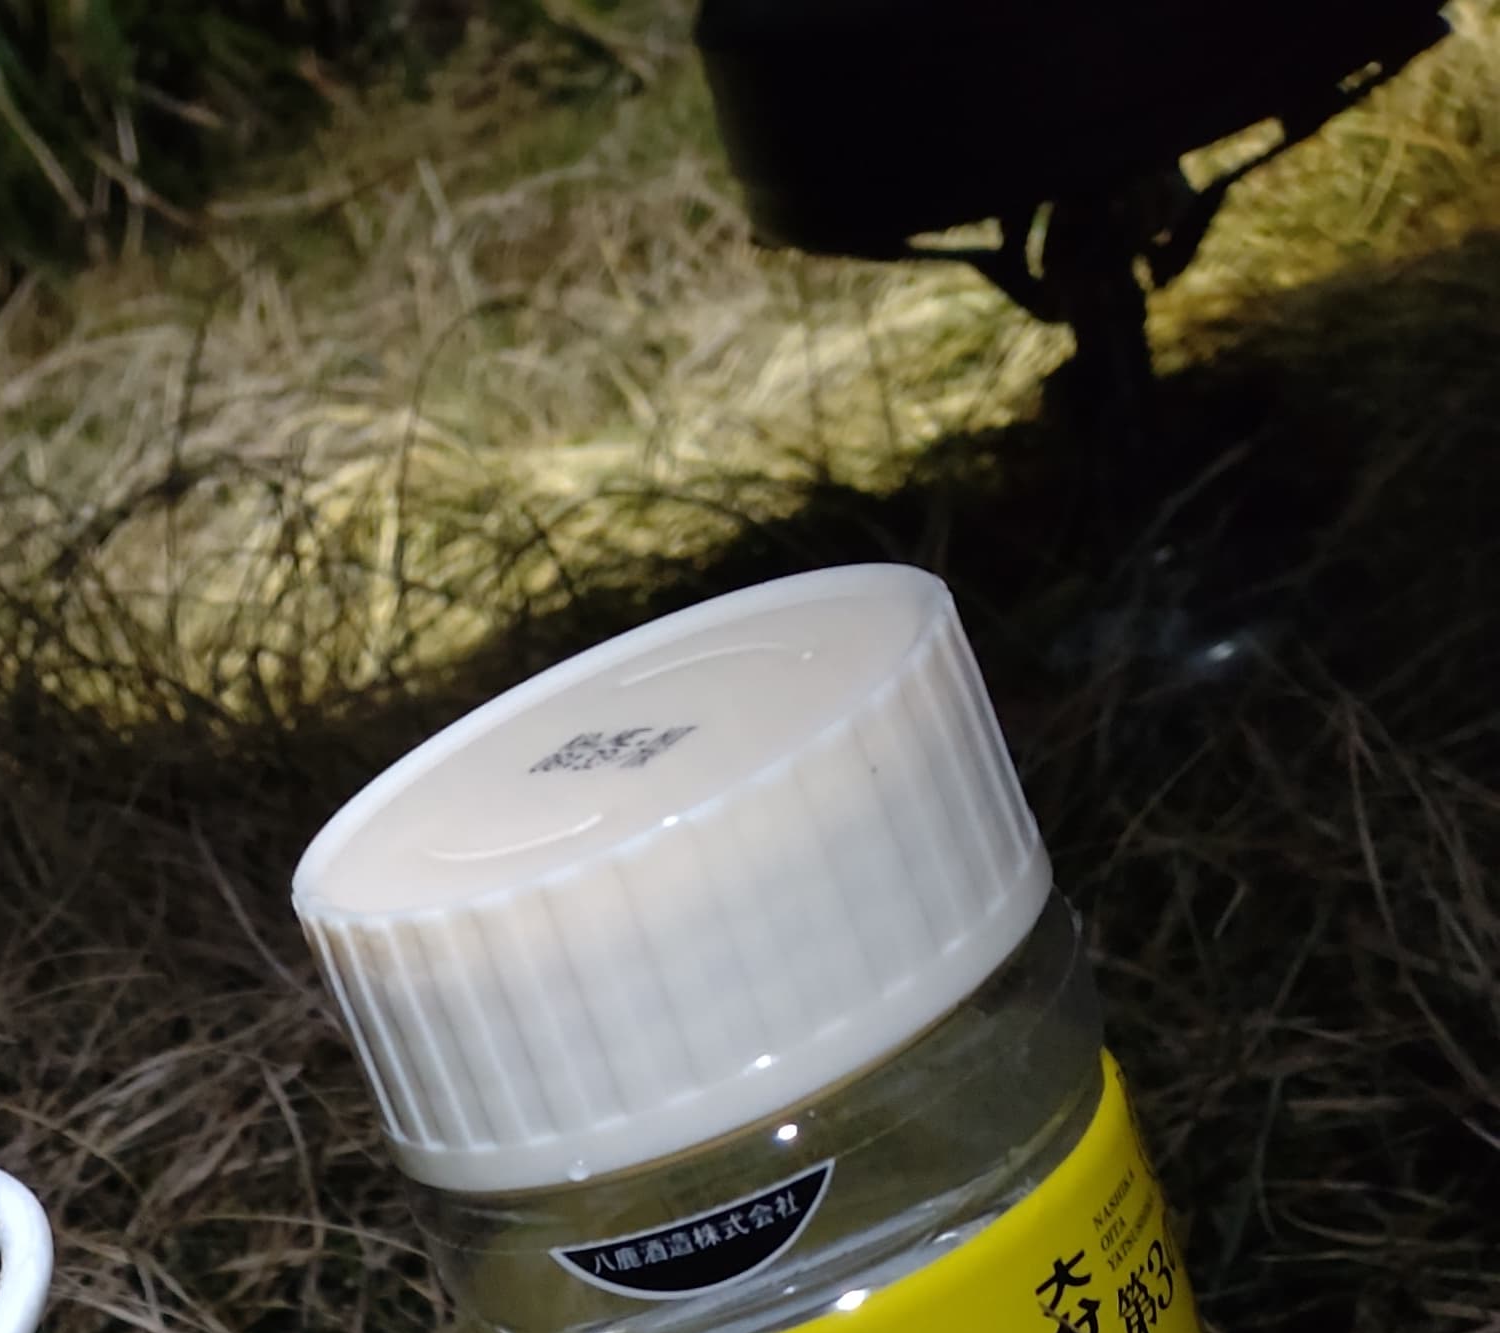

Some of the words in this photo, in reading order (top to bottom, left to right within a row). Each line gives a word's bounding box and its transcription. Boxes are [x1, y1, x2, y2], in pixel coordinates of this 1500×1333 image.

[594, 1191, 800, 1274] 八鹿酒造株式会社
